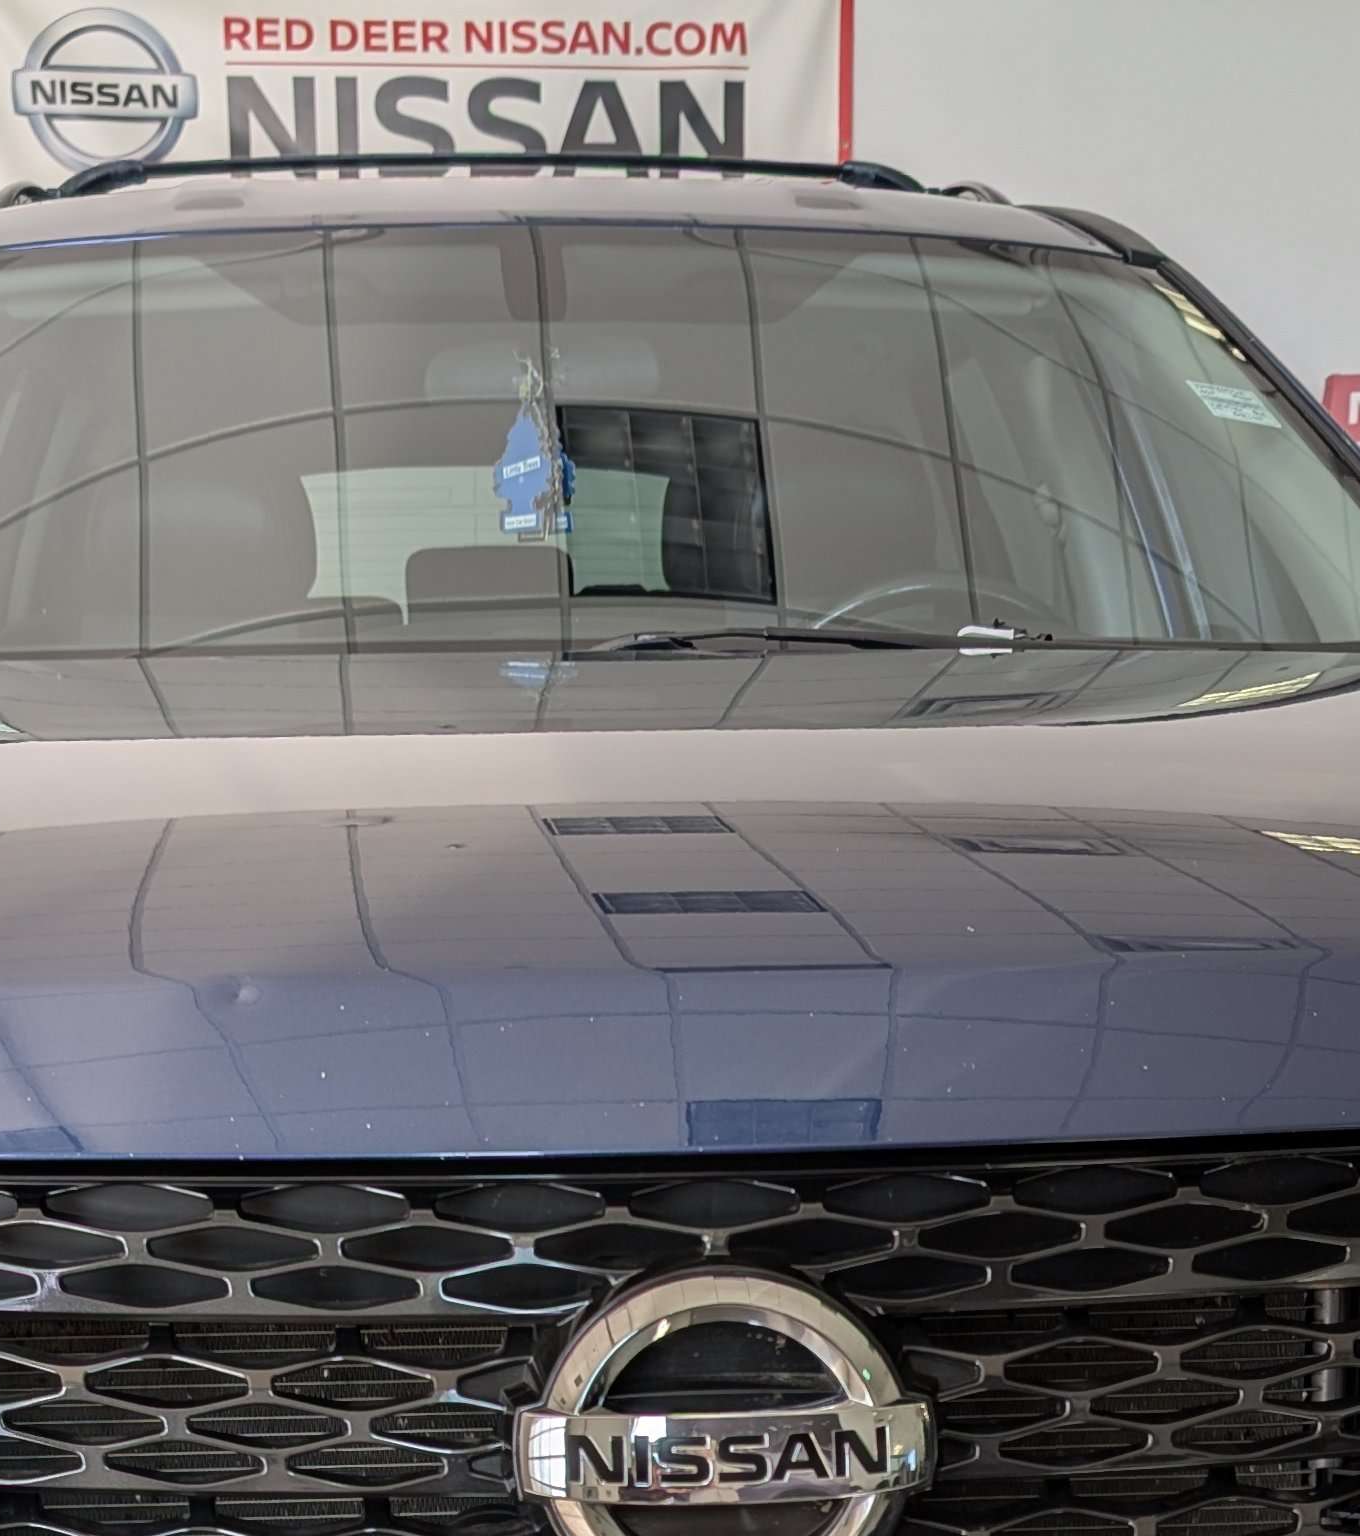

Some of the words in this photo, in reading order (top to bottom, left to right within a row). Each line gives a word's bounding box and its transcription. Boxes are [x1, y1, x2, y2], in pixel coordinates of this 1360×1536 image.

[223, 16, 315, 54] RED
[327, 17, 449, 56] DEER
[464, 19, 749, 57] NISSAN.COM
[30, 80, 180, 110] NISSAN
[227, 74, 746, 179] NISSAN
[567, 1425, 890, 1488] NISSAN
